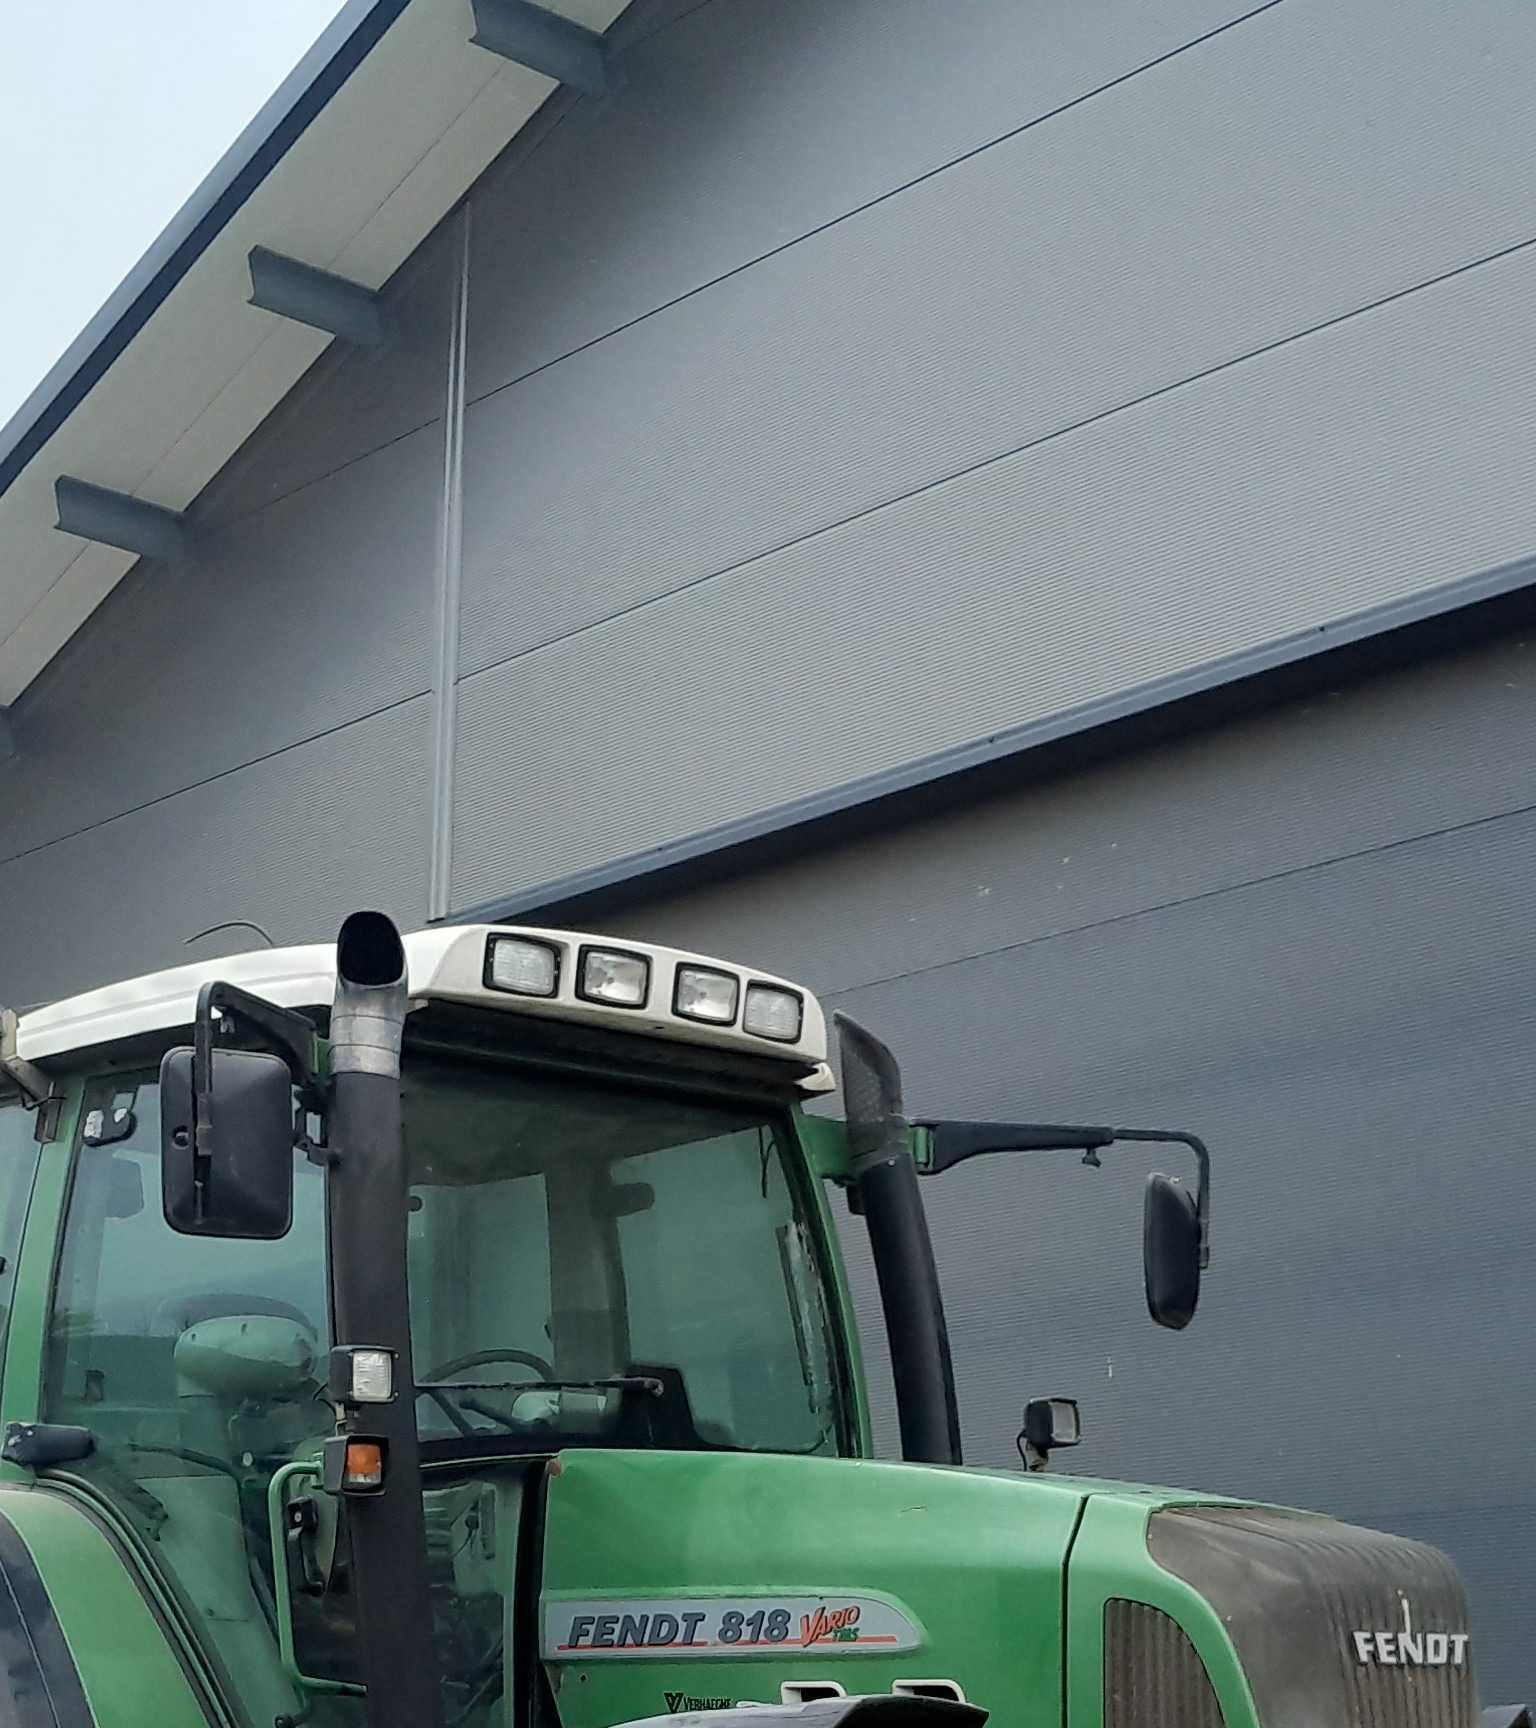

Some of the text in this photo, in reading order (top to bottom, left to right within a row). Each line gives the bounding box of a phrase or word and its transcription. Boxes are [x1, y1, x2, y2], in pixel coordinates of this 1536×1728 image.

[568, 1605, 861, 1648] FENDT 818 VARIO
[1352, 1631, 1469, 1665] FENDT
